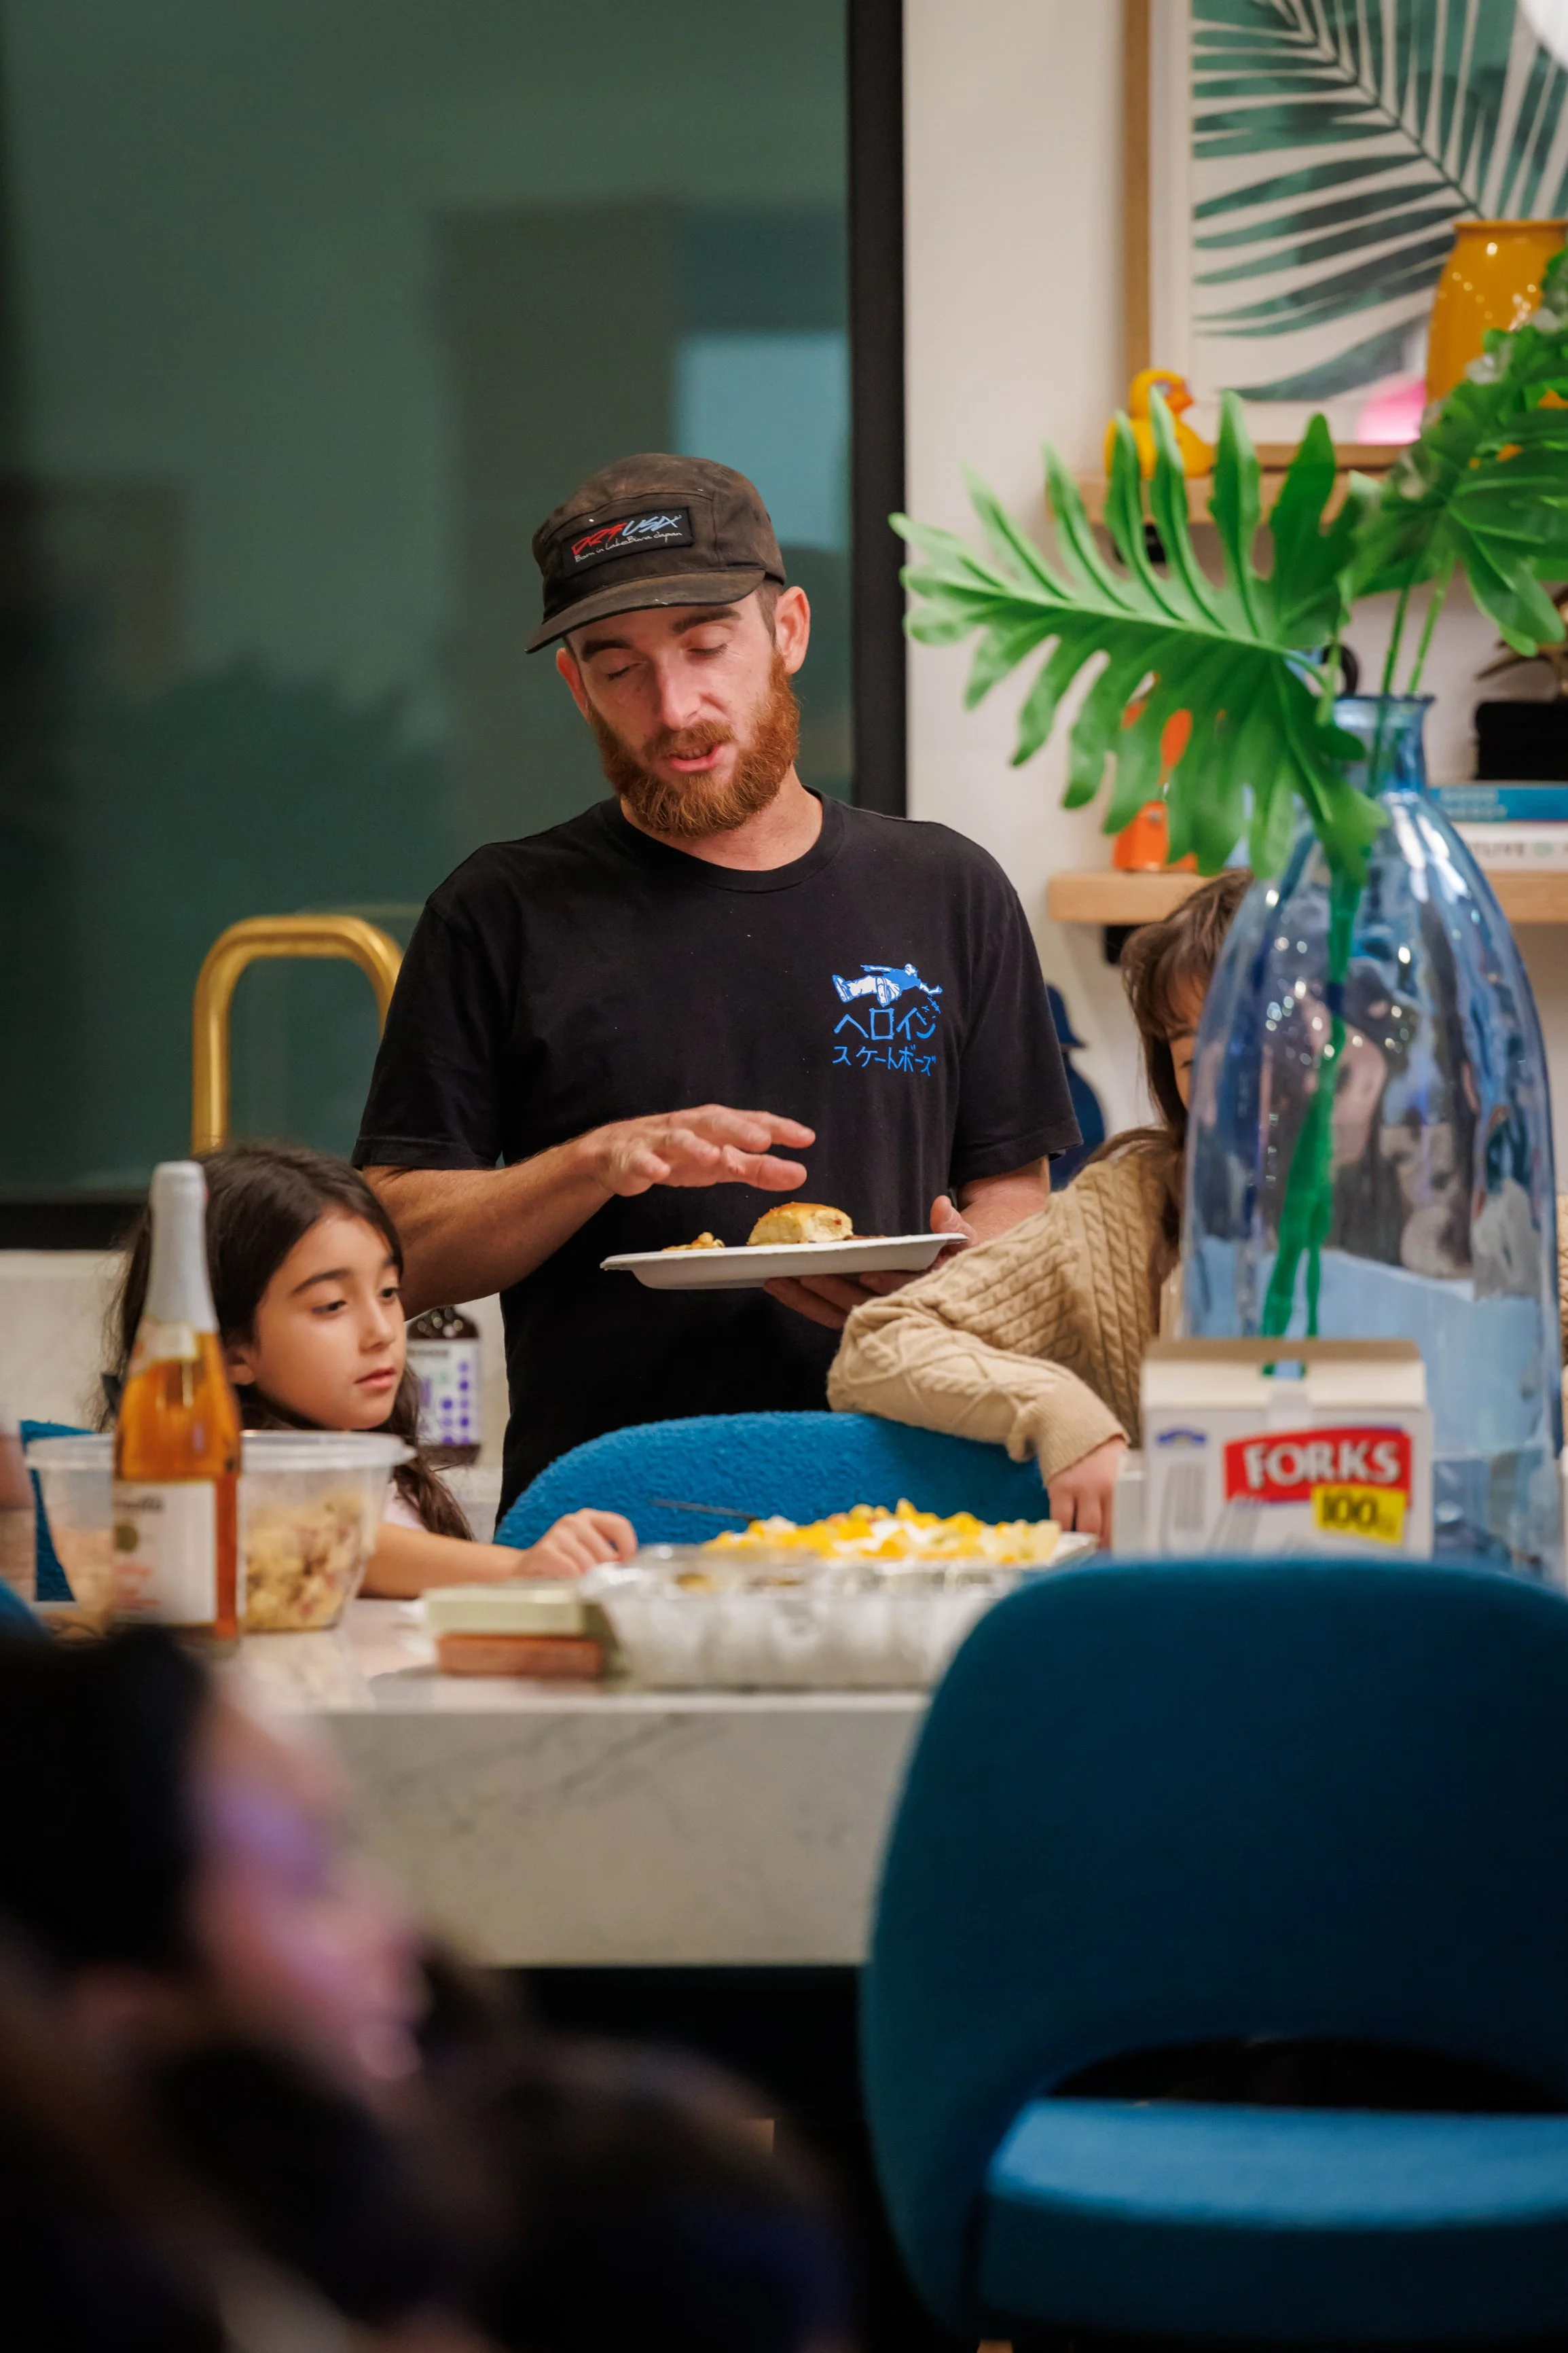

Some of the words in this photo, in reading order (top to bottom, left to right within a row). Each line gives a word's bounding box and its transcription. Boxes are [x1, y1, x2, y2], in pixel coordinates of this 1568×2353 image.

[833, 1007, 936, 1041] ヘロイン
[1243, 1440, 1402, 1490] FORKS
